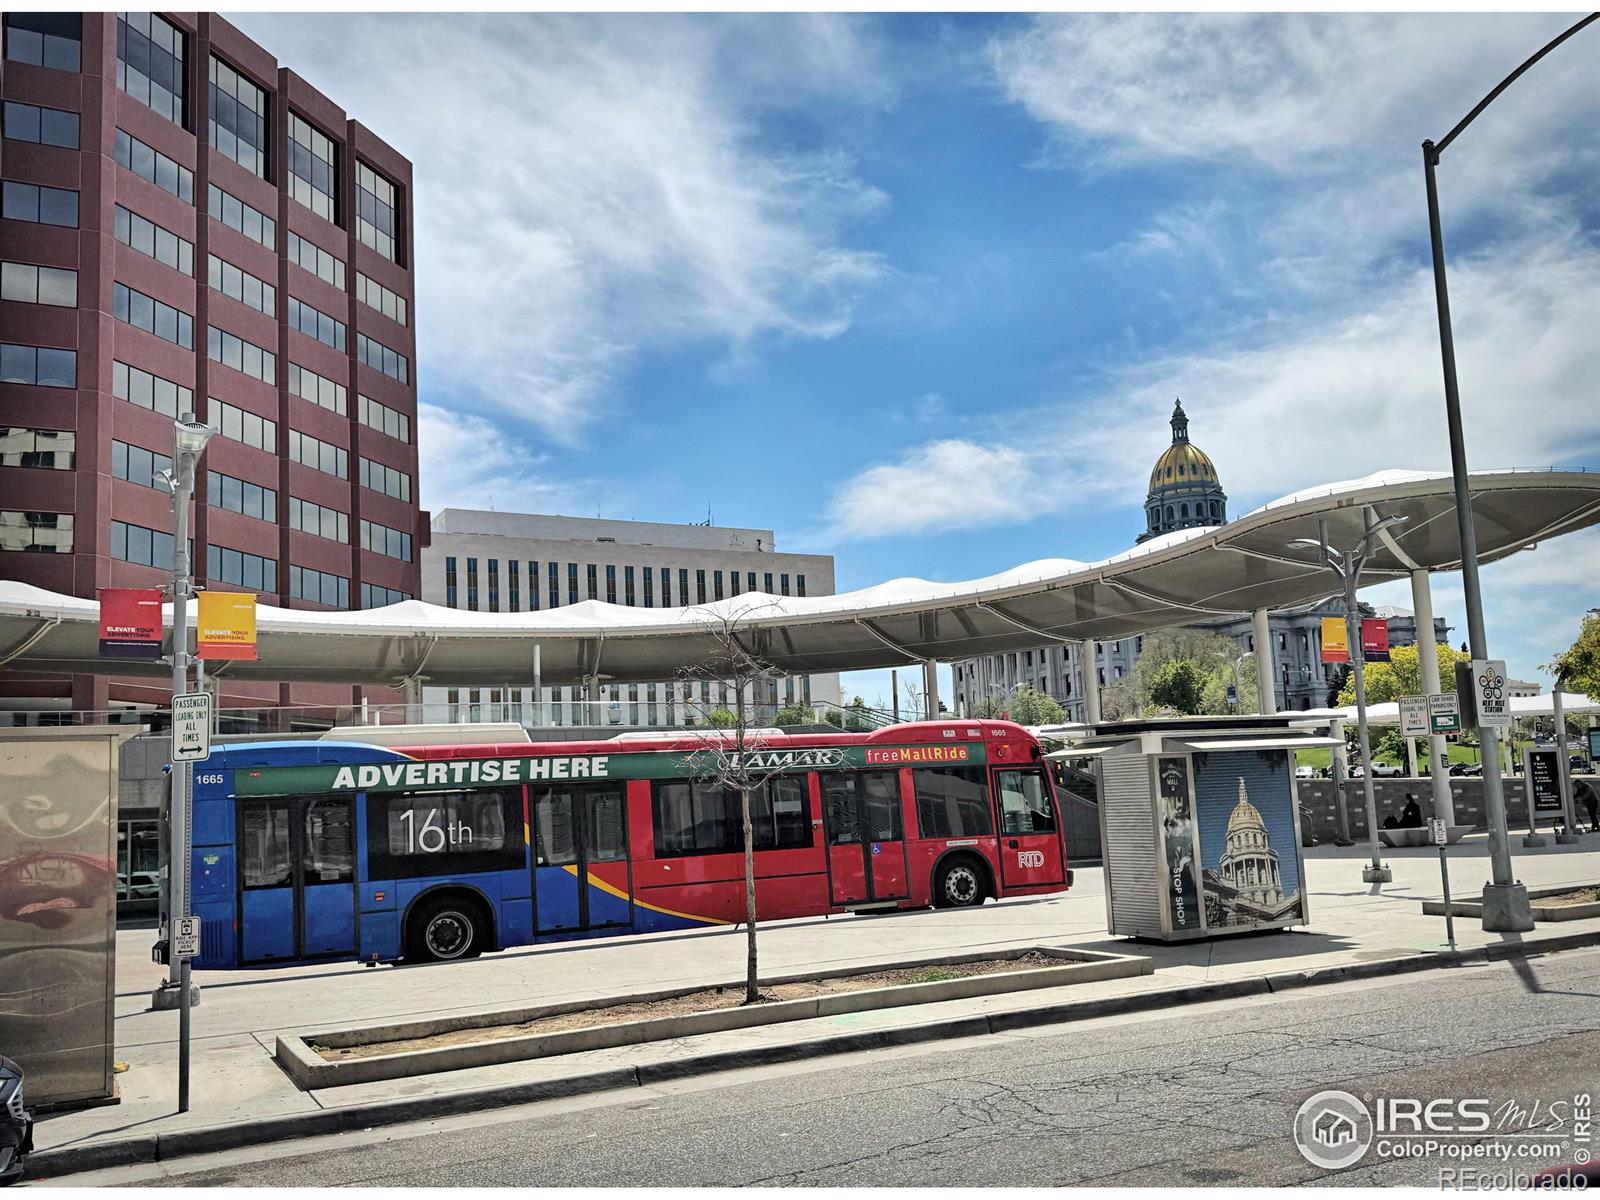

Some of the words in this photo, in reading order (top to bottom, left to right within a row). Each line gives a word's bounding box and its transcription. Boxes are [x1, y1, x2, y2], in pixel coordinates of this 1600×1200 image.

[175, 698, 207, 709] PASSENGER
[176, 711, 194, 721] LOADING
[195, 710, 207, 720] ONLY
[185, 722, 196, 731] ALL
[182, 733, 200, 742] TIMES
[730, 750, 832, 768] LAMAR
[196, 774, 224, 784] 1665
[332, 760, 521, 789] ADVERTISE
[529, 757, 609, 780] HERE
[400, 808, 472, 853] 16th
[1017, 851, 1044, 868] RTD
[1173, 867, 1183, 894] STOP
[1175, 896, 1186, 925] SHOP
